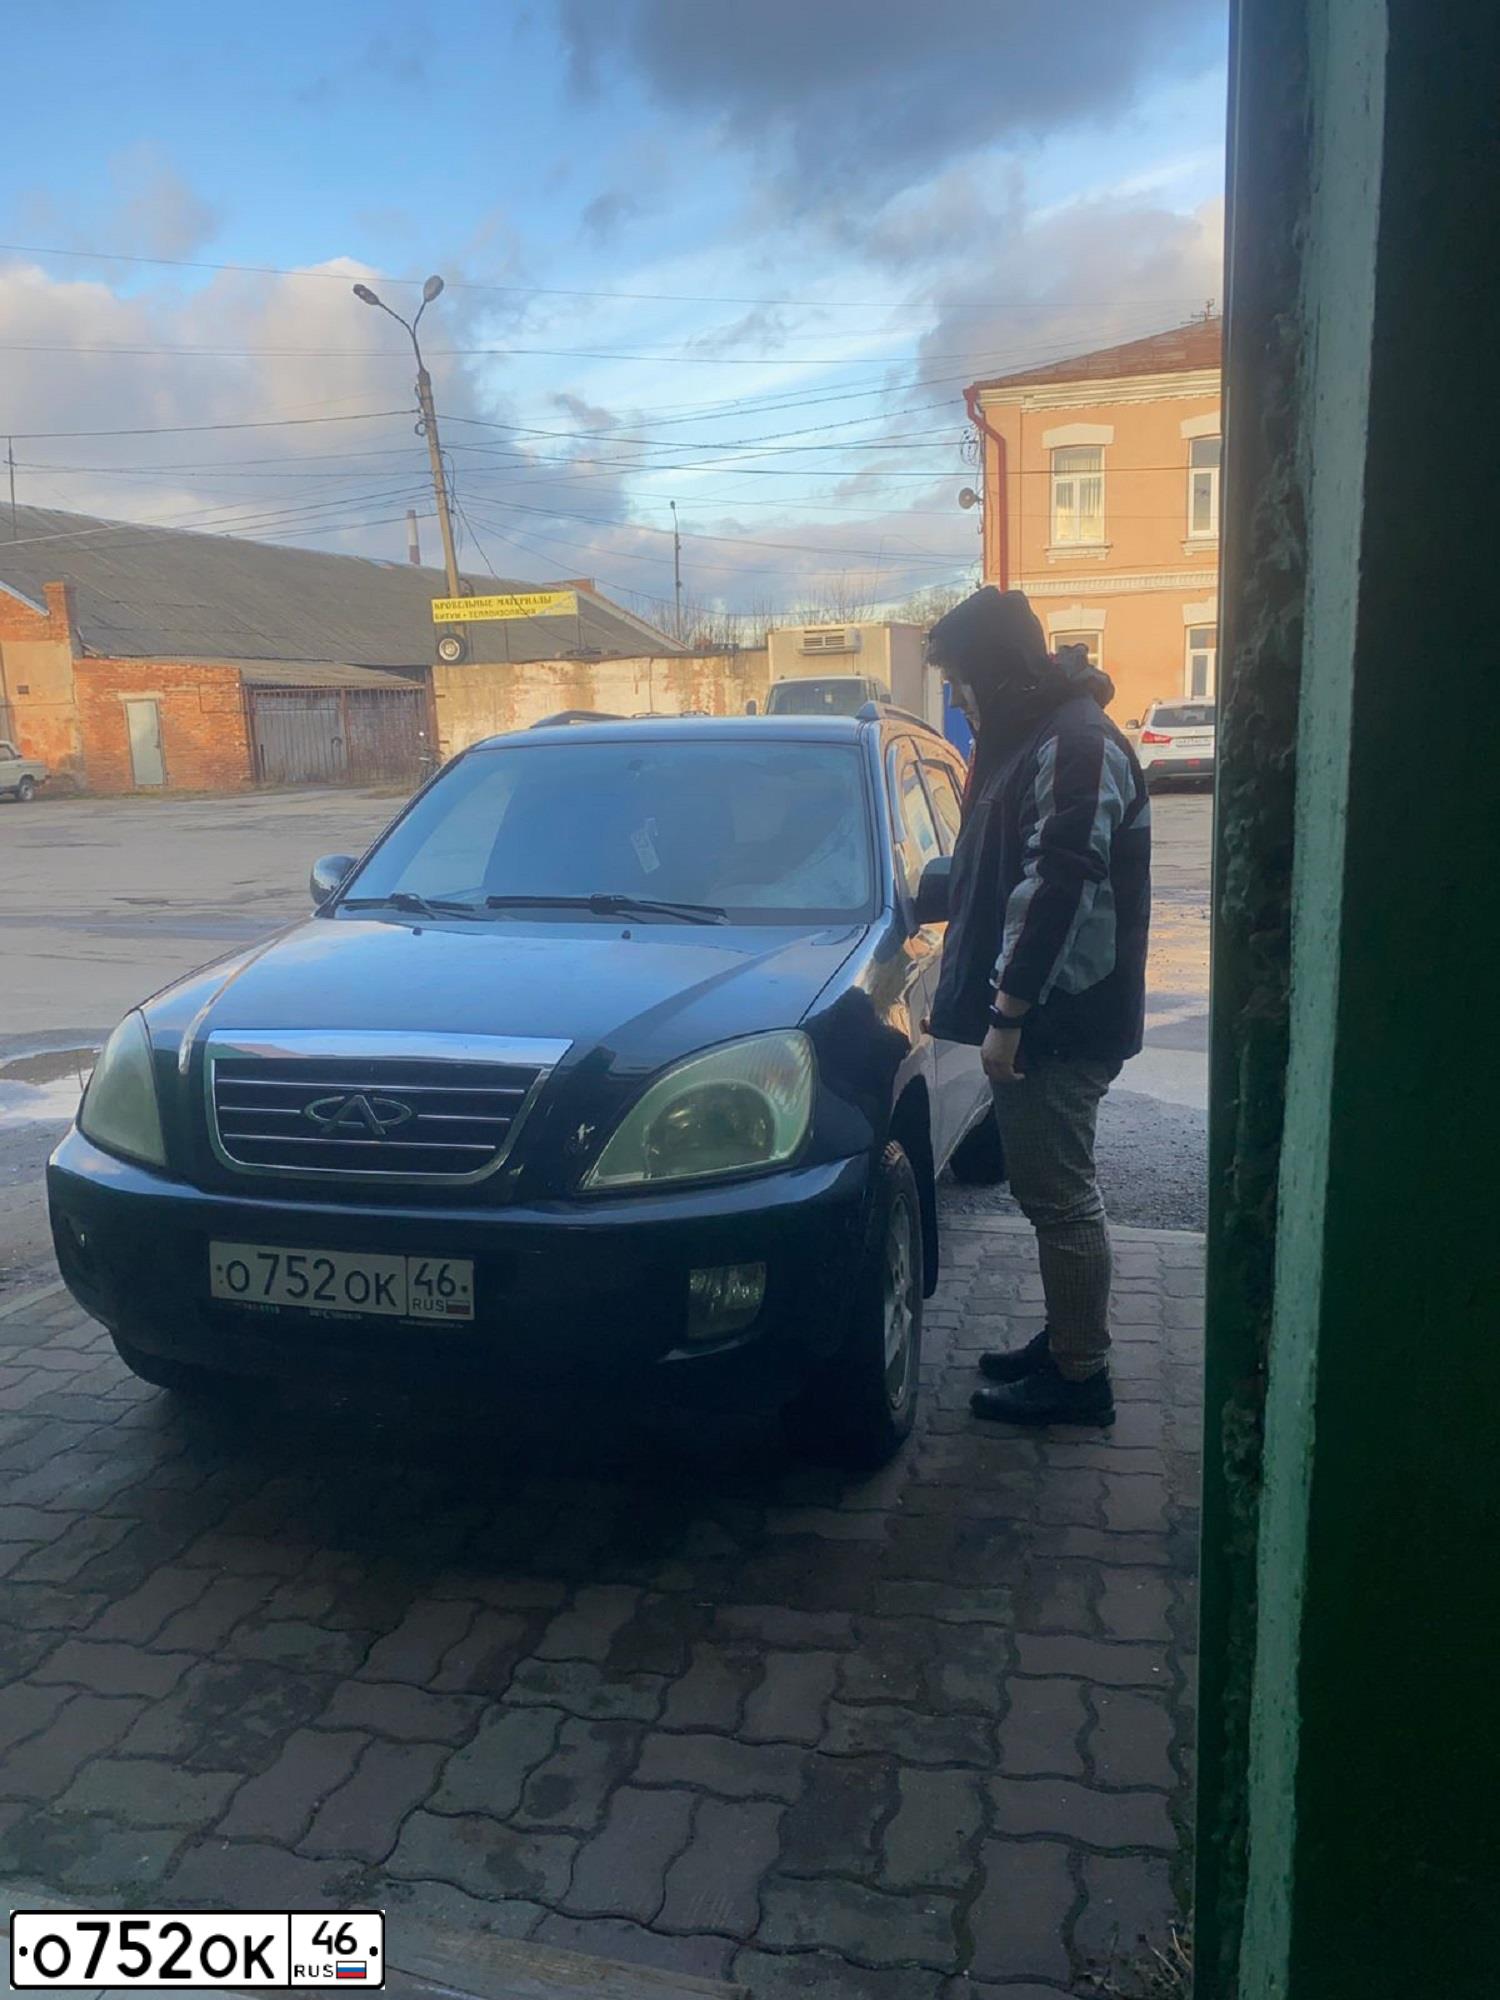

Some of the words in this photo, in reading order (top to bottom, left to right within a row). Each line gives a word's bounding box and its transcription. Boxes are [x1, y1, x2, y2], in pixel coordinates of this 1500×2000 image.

[226, 1252, 397, 1307] О752ОК
[413, 1262, 457, 1297] 46
[412, 1297, 445, 1312] RUS
